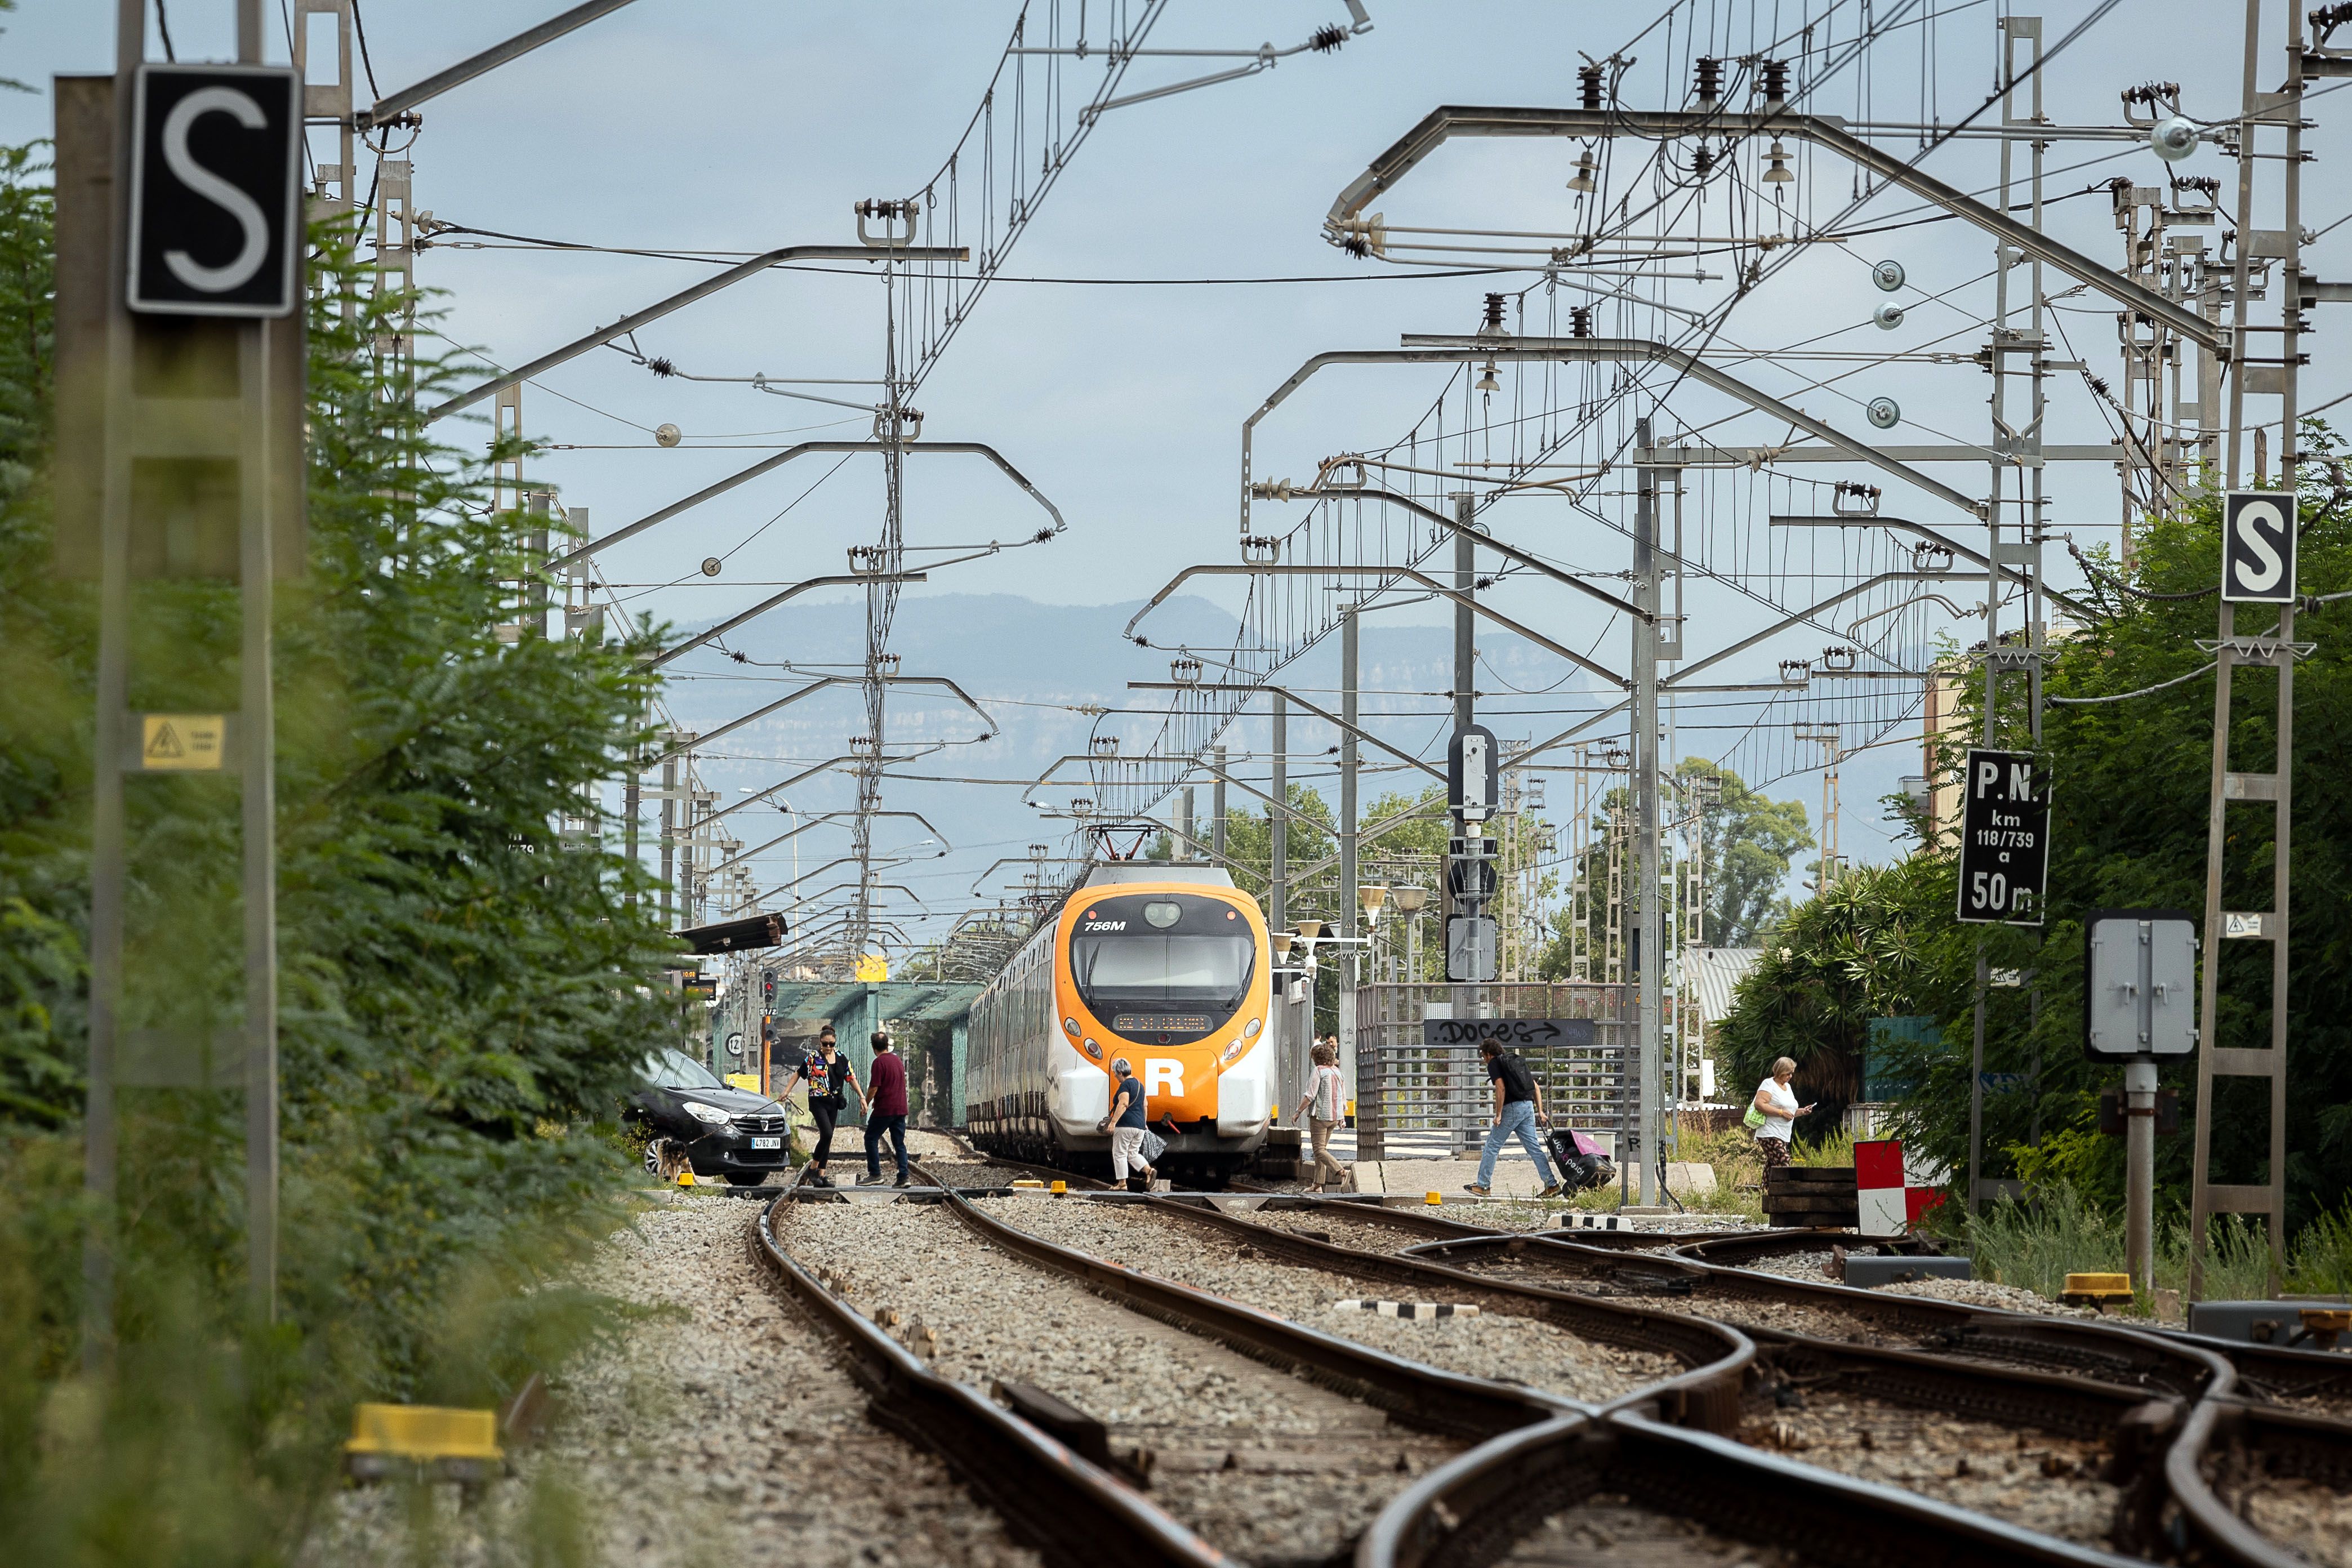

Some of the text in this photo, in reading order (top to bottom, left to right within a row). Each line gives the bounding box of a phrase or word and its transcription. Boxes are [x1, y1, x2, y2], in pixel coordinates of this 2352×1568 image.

[162, 86, 270, 292] S
[2235, 501, 2284, 592] S
[1992, 809, 2020, 826] km
[1977, 830, 2034, 848] 118/739
[1999, 852, 2010, 863] a
[1972, 872, 2032, 912] 50 m
[1085, 921, 1126, 931] 756M
[1144, 1059, 1184, 1098] R
